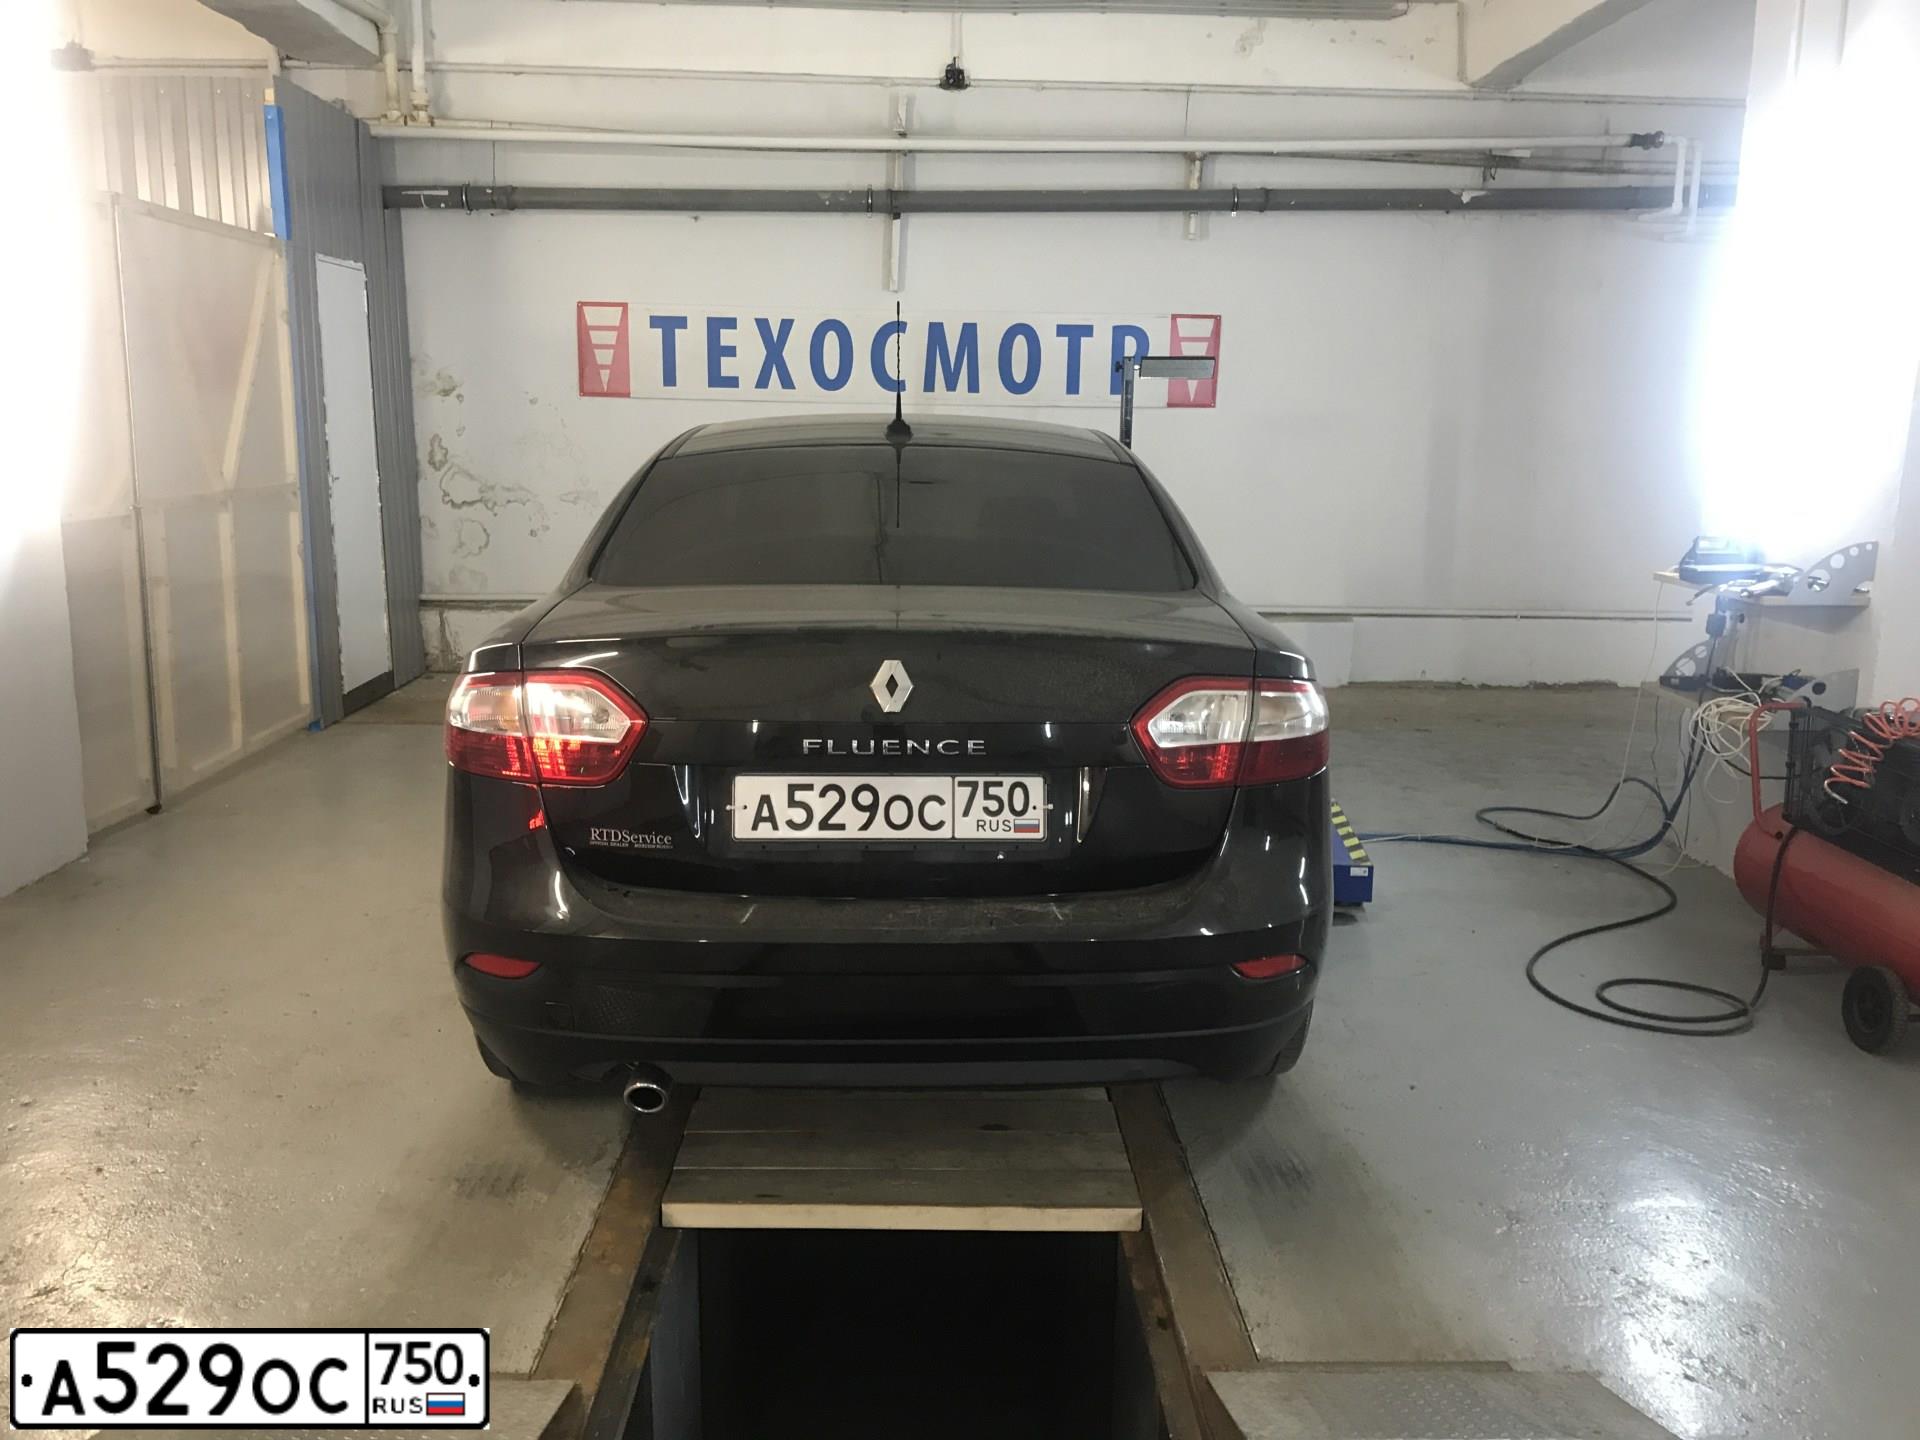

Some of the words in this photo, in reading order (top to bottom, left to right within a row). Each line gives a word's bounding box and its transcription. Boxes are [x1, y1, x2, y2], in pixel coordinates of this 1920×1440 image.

[649, 315, 1150, 395] ТЕХОСМОТР
[802, 738, 987, 756] FLUENCE
[957, 780, 1030, 818] 750
[976, 819, 1012, 832] RUS
[590, 827, 673, 845] RTDService
